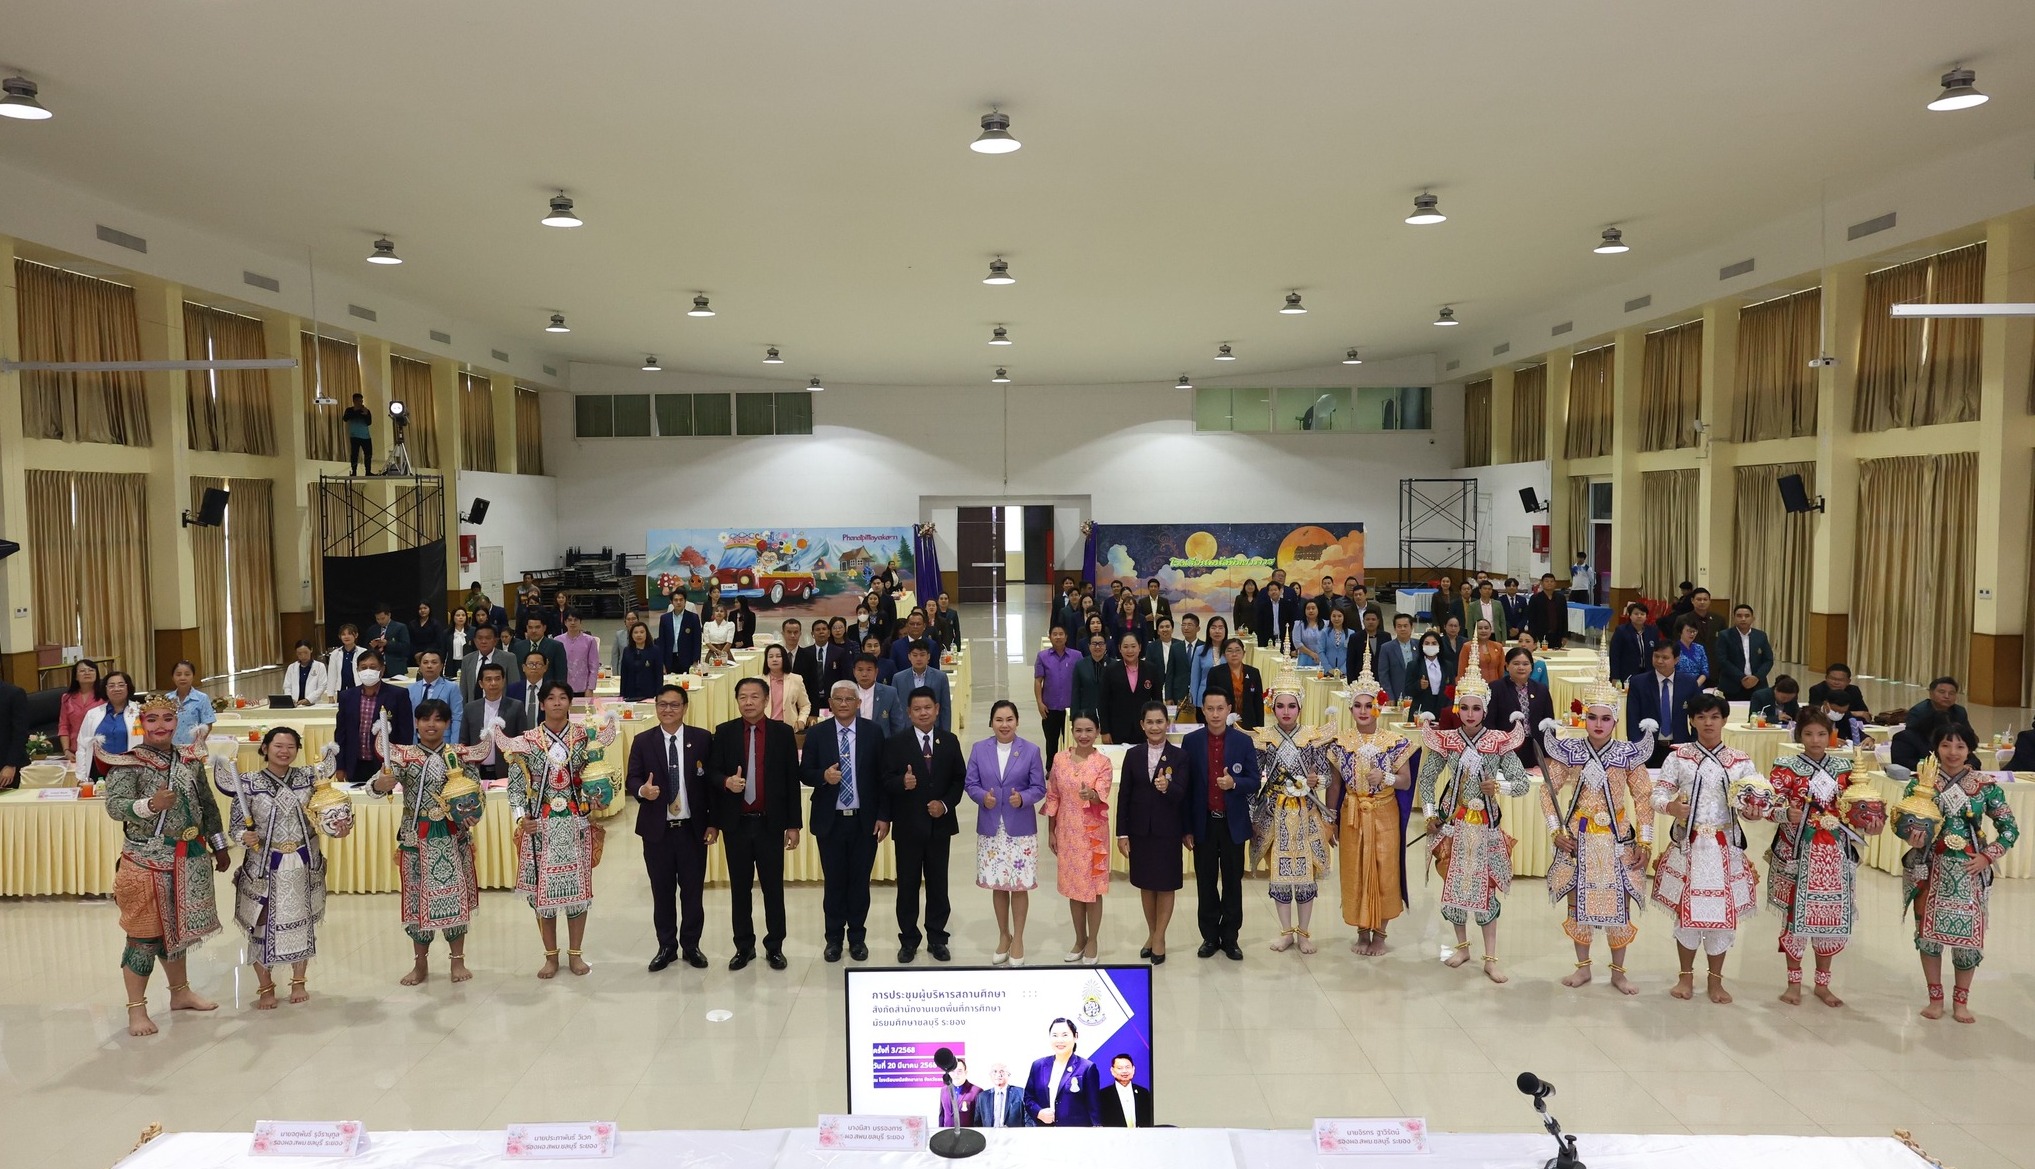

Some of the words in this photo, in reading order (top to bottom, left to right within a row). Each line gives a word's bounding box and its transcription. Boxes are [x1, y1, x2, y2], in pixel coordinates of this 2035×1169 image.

[872, 989, 1006, 1001] การประชุมผู้บริหารสถานศึกษา
[872, 1002, 1001, 1013] สังกัดสำนักงานเขตพื้นที่การศึกษา
[872, 1018, 939, 1028] มัธยมศึกษาชลบุรี
[941, 1018, 966, 1026] ระยอง
[891, 1046, 916, 1054] 3/2568
